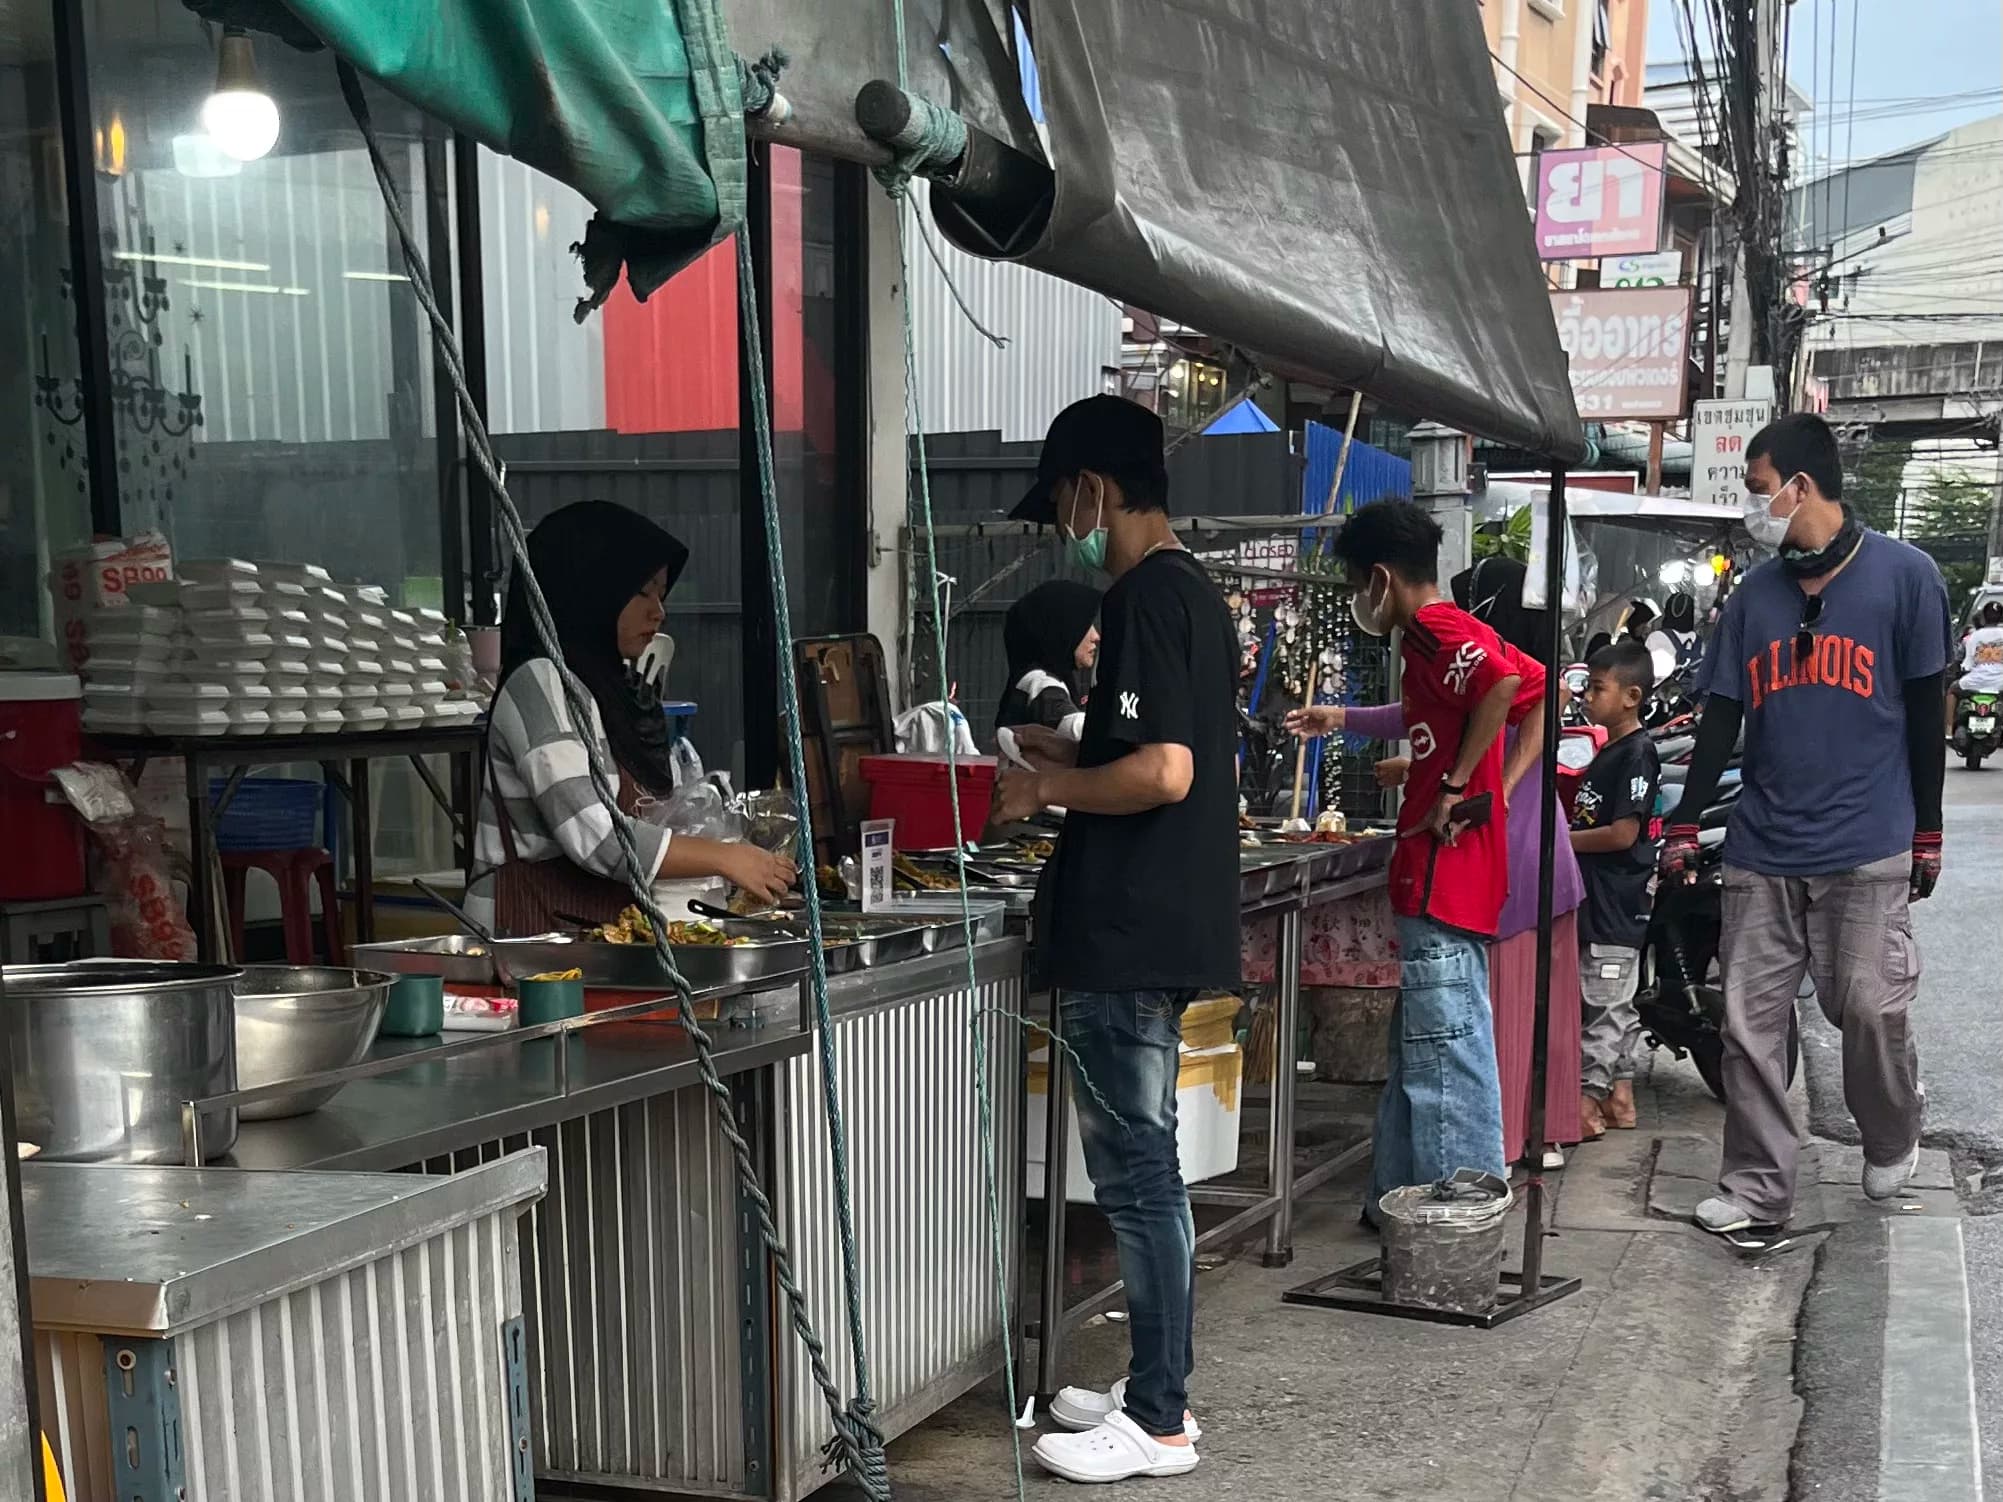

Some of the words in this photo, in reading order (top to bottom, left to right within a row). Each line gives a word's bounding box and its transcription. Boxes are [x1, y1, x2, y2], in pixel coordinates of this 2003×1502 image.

[1546, 159, 1644, 223] ยา
[1716, 435, 1742, 454] ลด
[1747, 634, 1876, 710] ILINOIS
[1119, 691, 1140, 720] NY
